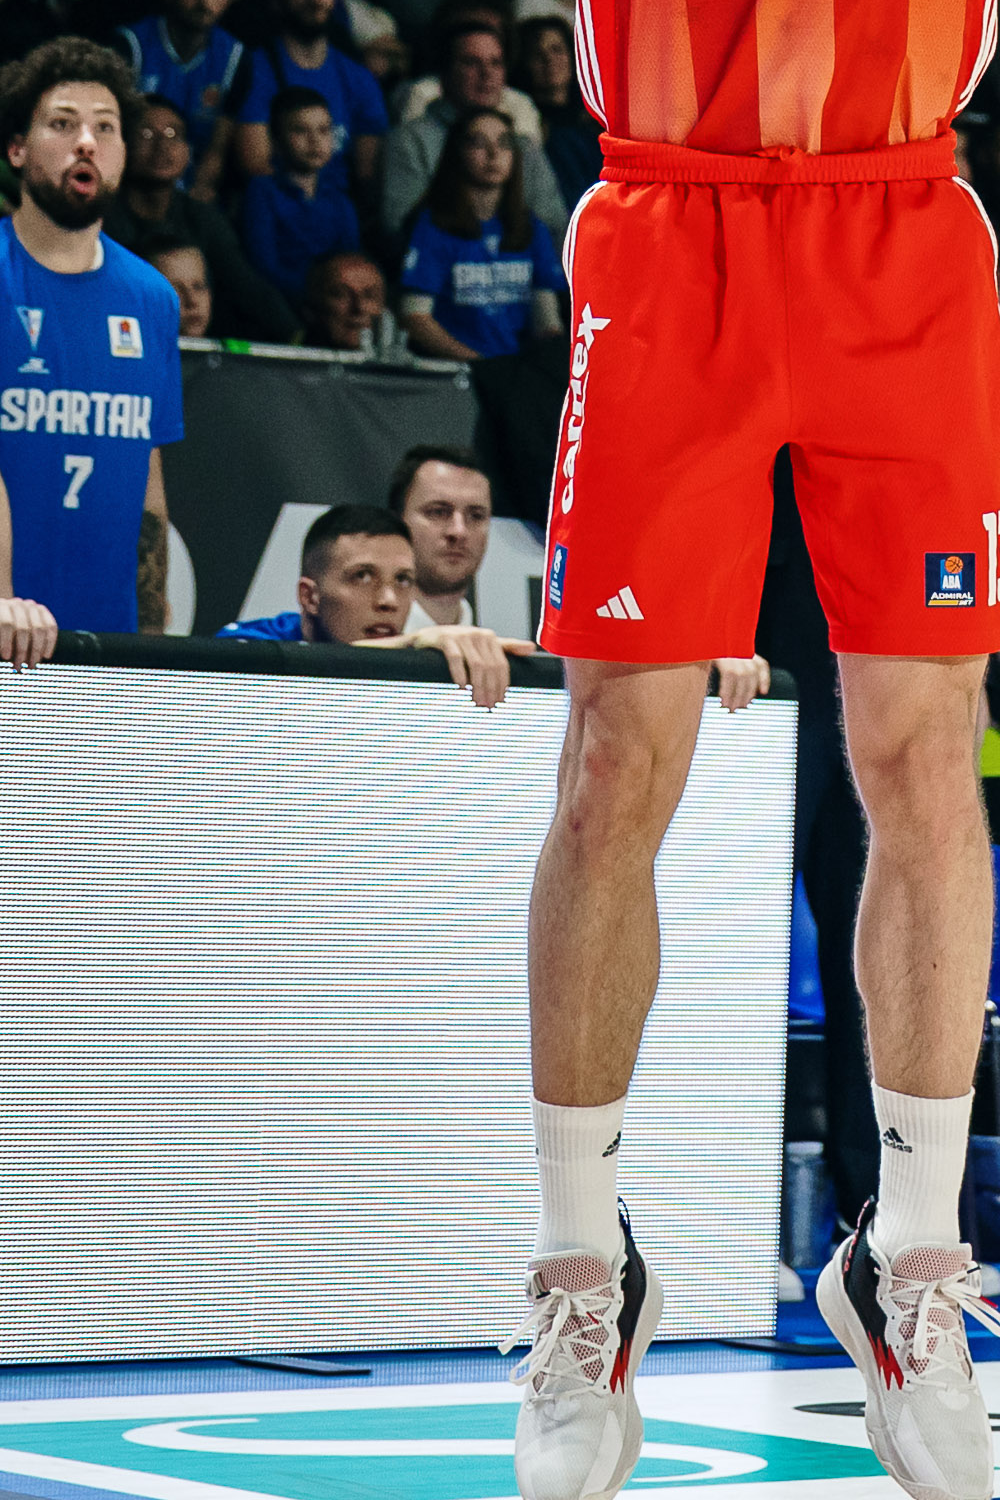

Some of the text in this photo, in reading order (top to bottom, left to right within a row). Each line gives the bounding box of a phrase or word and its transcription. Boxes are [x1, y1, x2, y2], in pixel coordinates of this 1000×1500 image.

[0, 387, 152, 440] SPARTAK
[63, 454, 94, 509] 7
[930, 591, 974, 600] ADMIRAL
[942, 574, 962, 589] ABA
